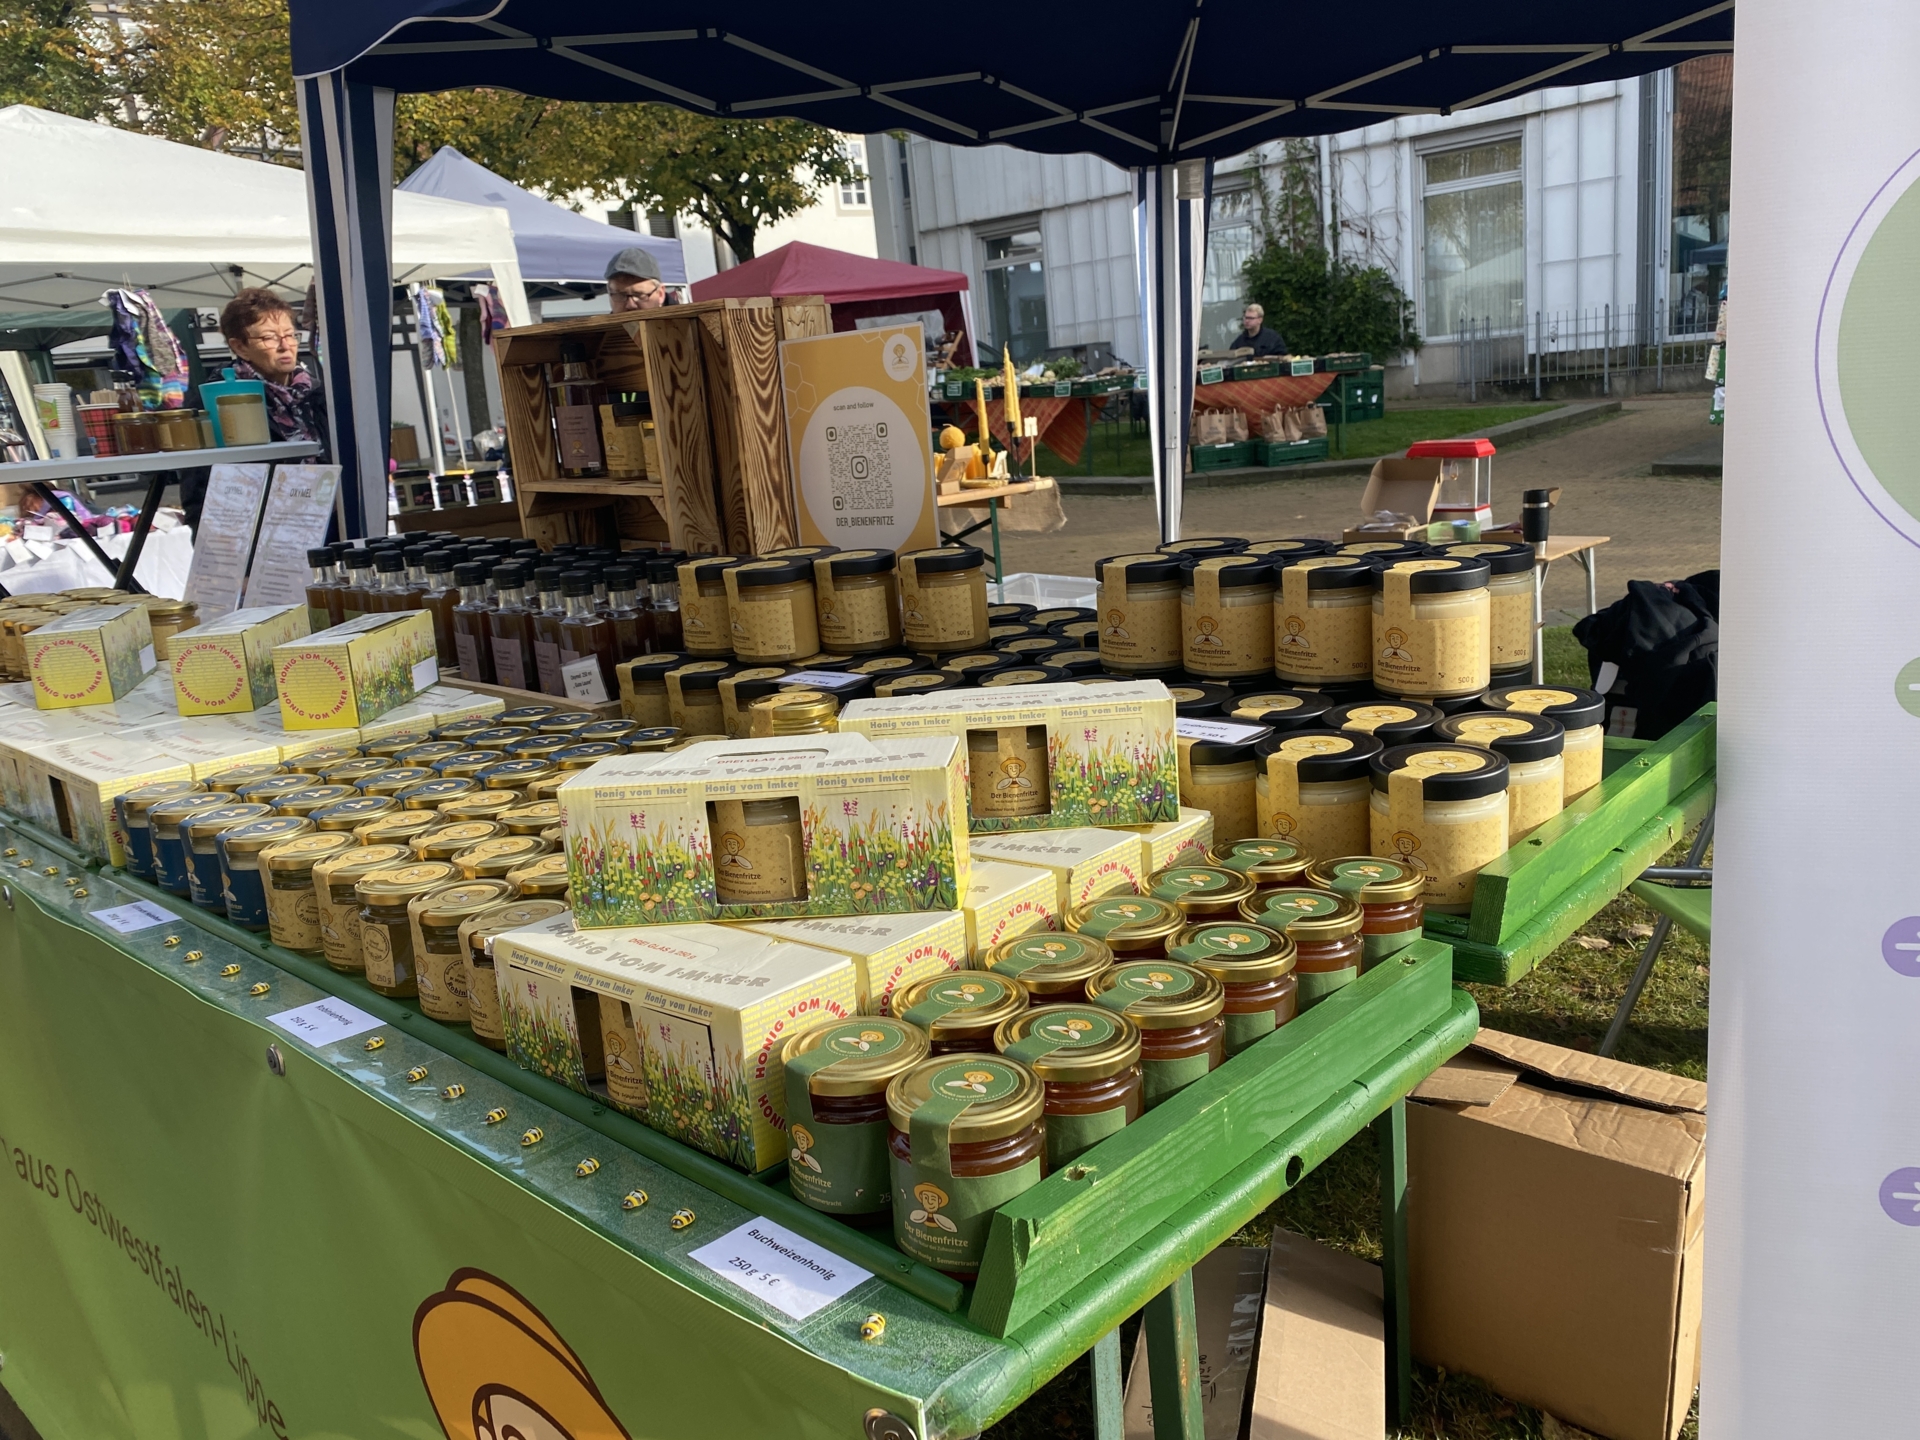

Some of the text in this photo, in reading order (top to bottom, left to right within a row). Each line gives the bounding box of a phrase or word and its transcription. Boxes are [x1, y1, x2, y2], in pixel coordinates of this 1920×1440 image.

[833, 401, 874, 411] scan and follow
[836, 516, 894, 527] DER_BIENENFRITZE
[33, 639, 101, 669] HONIG VOM IMKER
[175, 643, 242, 674] HONIG VOM IMKER
[1513, 649, 1524, 657] 500
[280, 653, 346, 684] HONIG VOM IMKER
[1364, 662, 1368, 670] g
[1384, 661, 1421, 672] Bienenfritze
[35, 670, 102, 700] HONIG VOM IMKER
[1458, 676, 1470, 684] 500
[177, 676, 244, 708] HONIG VOM IMKER
[282, 689, 348, 721] HONIG VOM IMKER
[1060, 704, 1143, 718] Honig vom Imker
[870, 720, 897, 730] Honig
[923, 717, 951, 726] Imker
[965, 711, 1047, 724] Honig vom Imker
[705, 780, 799, 794] Honig vom Imker
[816, 773, 911, 787] Honig vom Imker
[594, 786, 688, 799] Honig vom Imker
[1002, 790, 1039, 799] Bienenfritze
[1176, 838, 1194, 853] VOM
[724, 869, 761, 880] Bienenfritze
[1096, 861, 1118, 877] VOM
[991, 919, 1008, 946] NIG
[1008, 901, 1032, 919] VOM
[628, 938, 648, 947] DREI
[648, 943, 671, 953] GLAS
[674, 949, 691, 958] 250
[511, 950, 565, 975] Honig vom Imker
[376, 974, 392, 985] 250 g
[573, 970, 635, 996] Honig vom Imker
[879, 945, 933, 1017] HONIG VOM
[446, 981, 468, 997] Robini
[644, 991, 713, 1018] Honig vom Imker
[755, 997, 849, 1079] HONIG VOM IMK
[757, 1093, 788, 1133] HONI
[794, 1166, 832, 1188] Bienenfritze
[808, 1193, 842, 1207] Sommertracht
[879, 1192, 891, 1204] 25
[904, 1220, 969, 1247] Der Bienenfritze
[747, 1228, 836, 1281] Buchweizenhonig
[937, 1246, 956, 1254] Zuhause
[917, 1250, 932, 1263] Honig
[936, 1256, 979, 1267] Sommertracht
[728, 1256, 780, 1287] 250 g 5 €
[13, 1147, 289, 1440] aus Ostwestfalen-Lippe
